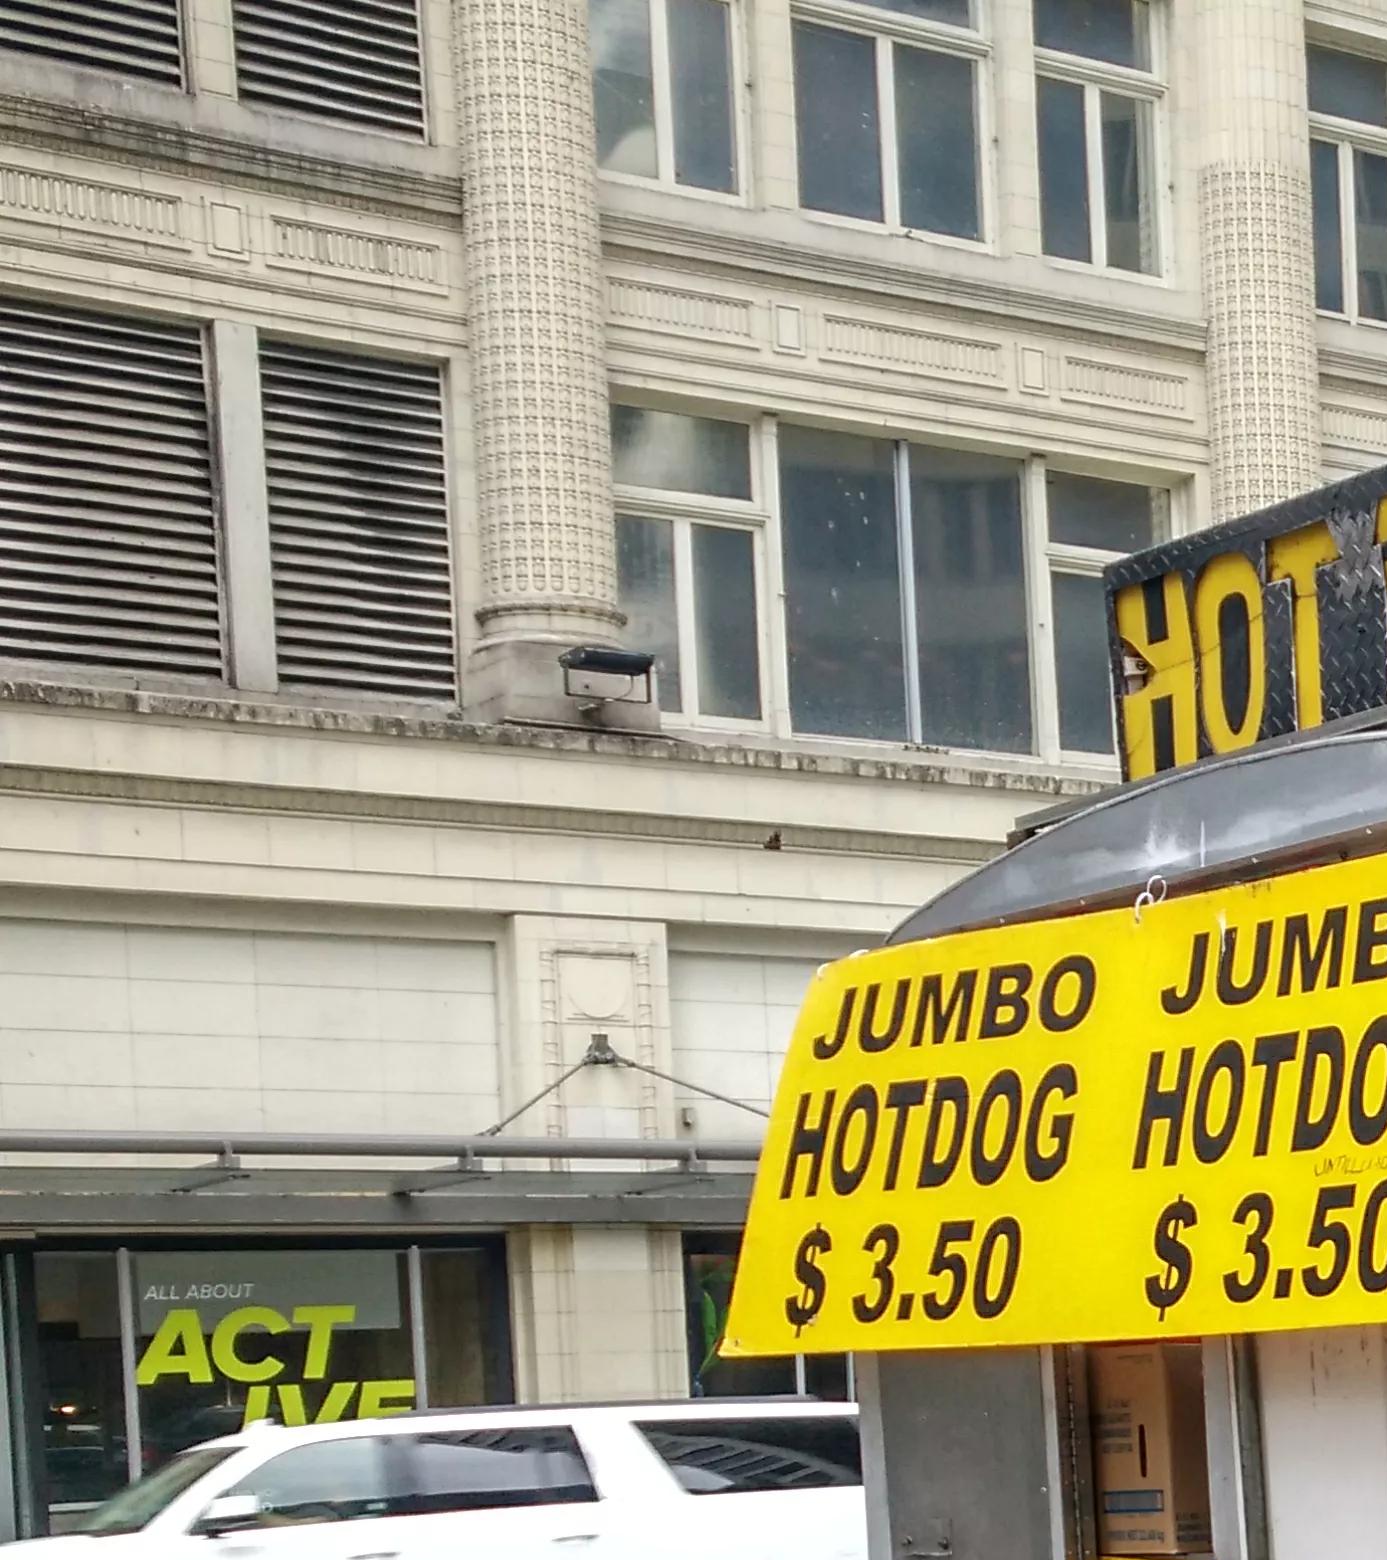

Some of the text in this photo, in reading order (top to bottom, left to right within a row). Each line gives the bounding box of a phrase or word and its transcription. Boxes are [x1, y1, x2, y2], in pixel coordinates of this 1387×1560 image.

[1114, 519, 1340, 783] HOT
[813, 955, 1096, 1060] JUMBO
[780, 1063, 1078, 1201] HOTDOG
[144, 1283, 255, 1300] ALL ABOUT
[786, 1216, 1021, 1338] $ 3.50
[1144, 1194, 1197, 1321] $
[136, 1305, 356, 1385] ACT
